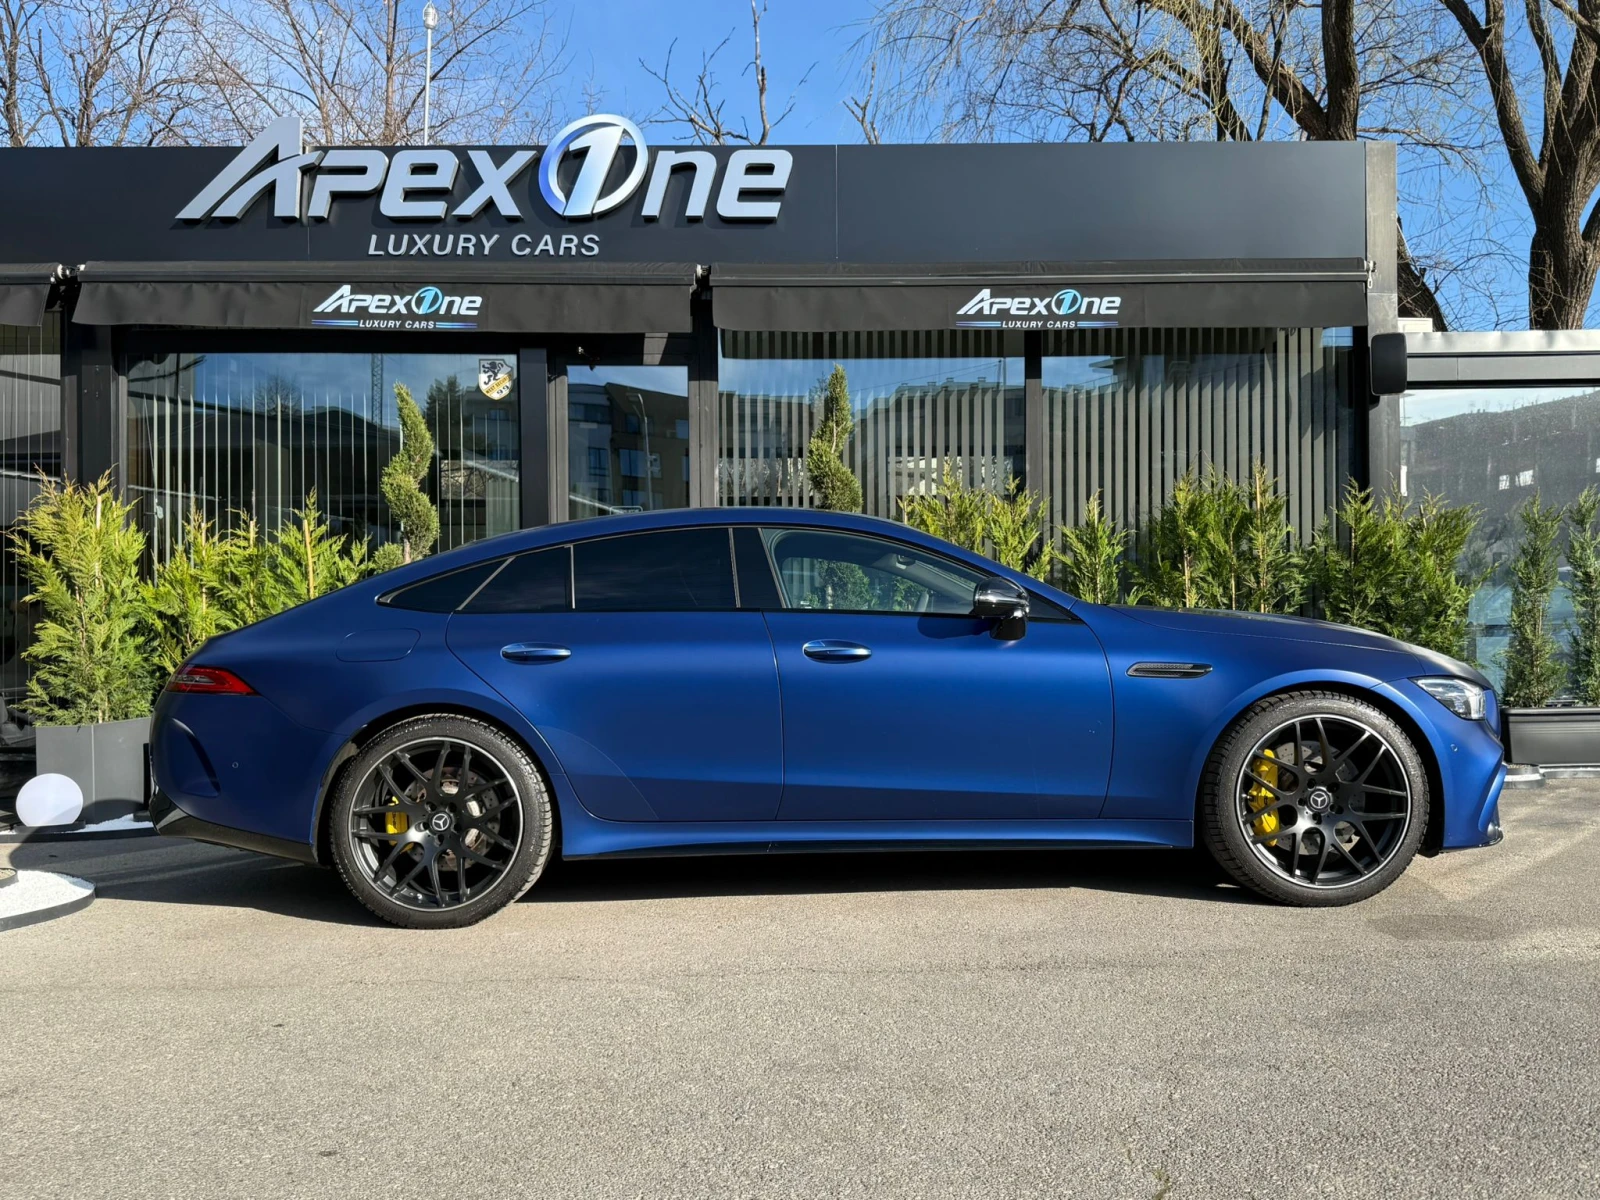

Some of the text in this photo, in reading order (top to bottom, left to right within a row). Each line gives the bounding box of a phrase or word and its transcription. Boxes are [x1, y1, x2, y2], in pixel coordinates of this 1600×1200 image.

[368, 234, 600, 256] LUXURY CARS
[359, 319, 435, 329] LUXURY CARS
[1002, 320, 1076, 328] LUXURY CARS
